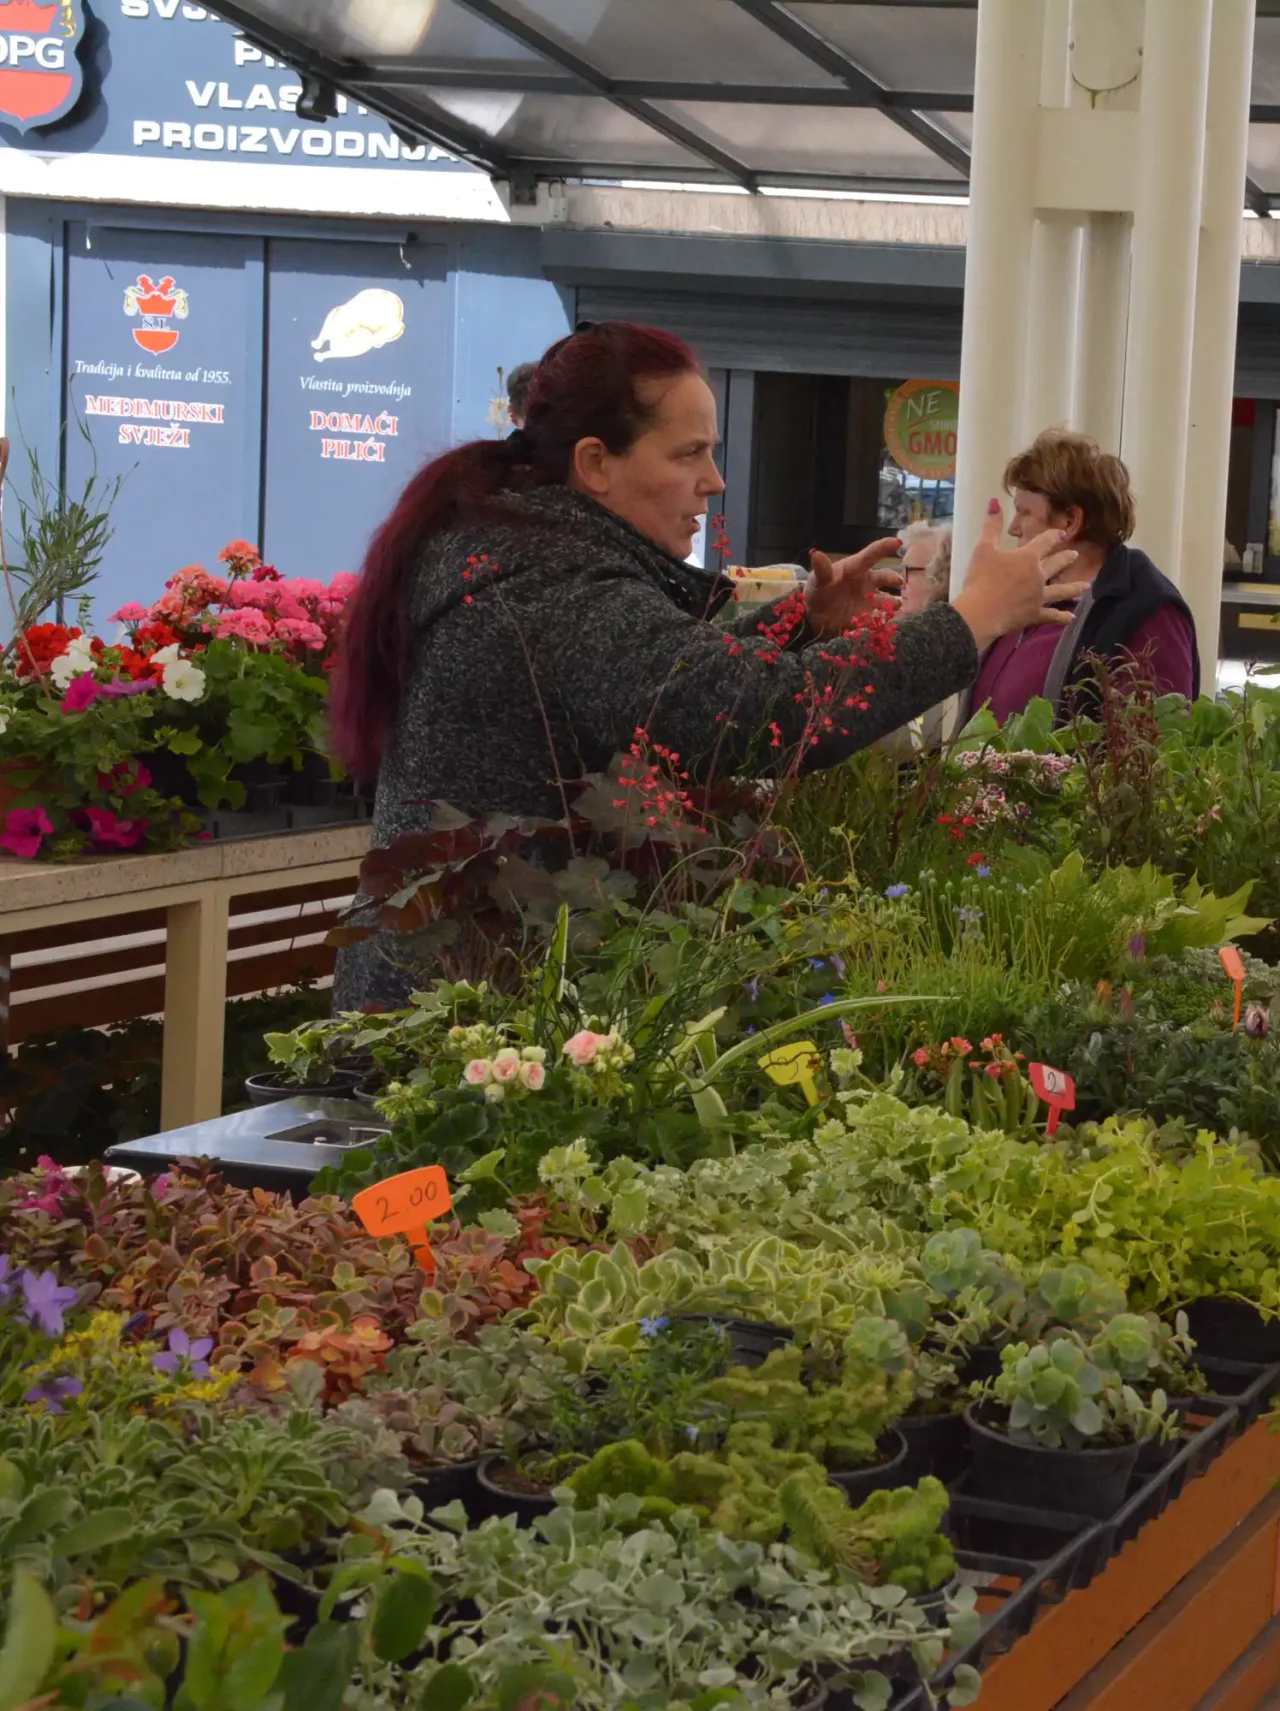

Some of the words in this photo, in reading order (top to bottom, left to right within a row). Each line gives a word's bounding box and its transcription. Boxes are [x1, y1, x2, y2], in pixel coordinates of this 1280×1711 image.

[0, 35, 65, 69] PG
[75, 360, 124, 381] Tradicija
[135, 363, 182, 381] kvaliteta
[185, 367, 202, 382] od
[202, 370, 232, 384] 1955.
[300, 375, 343, 393] Vlastita
[342, 380, 412, 402] proizvodnja
[906, 390, 942, 420] NE
[118, 422, 191, 448] SVJEŽI
[309, 410, 399, 436] DOMAĆI
[320, 436, 386, 462] PILIĆI
[908, 430, 958, 457] GMO
[376, 1180, 437, 1224] 2.00
